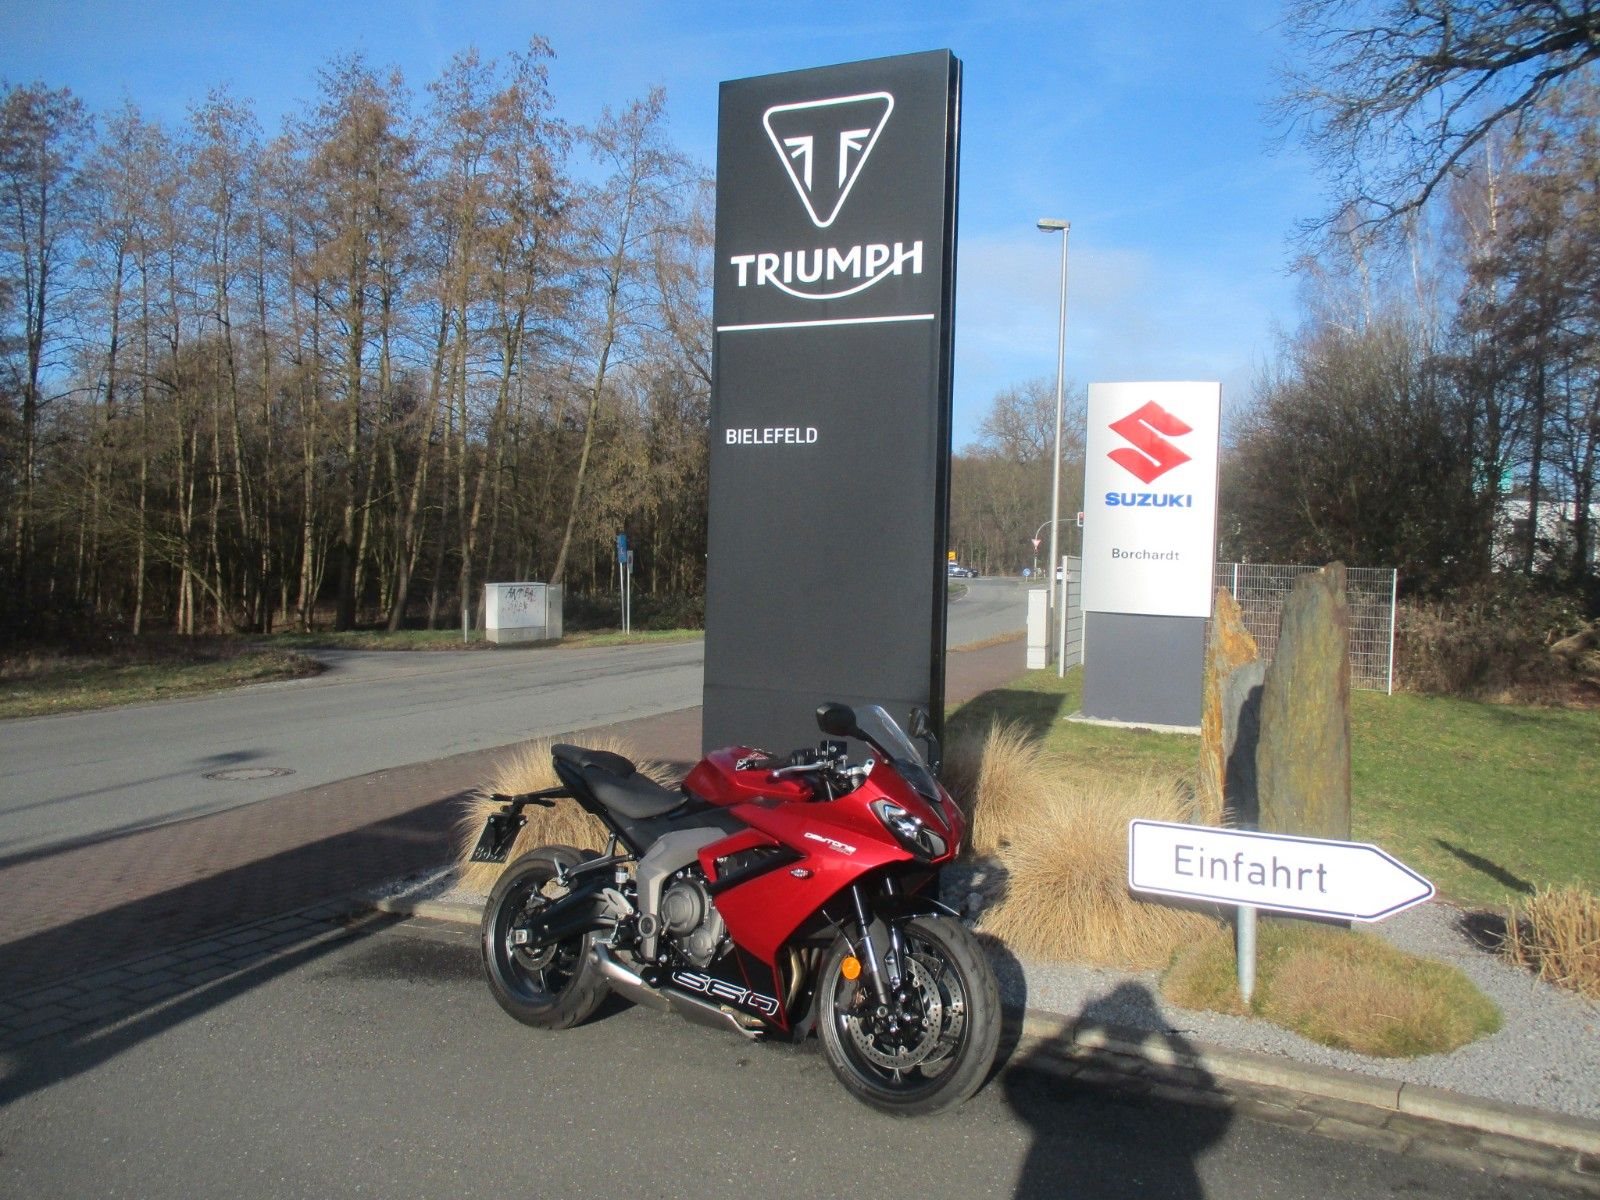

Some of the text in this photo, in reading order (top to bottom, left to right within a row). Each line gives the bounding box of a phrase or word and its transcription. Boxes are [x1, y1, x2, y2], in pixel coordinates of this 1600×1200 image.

[730, 241, 923, 299] TRIUMPH
[725, 426, 818, 445] BIELEFELD
[1105, 492, 1192, 508] SUZUKI
[1111, 547, 1180, 561] Borchardt
[1174, 843, 1327, 894] Einfahrt
[671, 971, 780, 1016] 660
